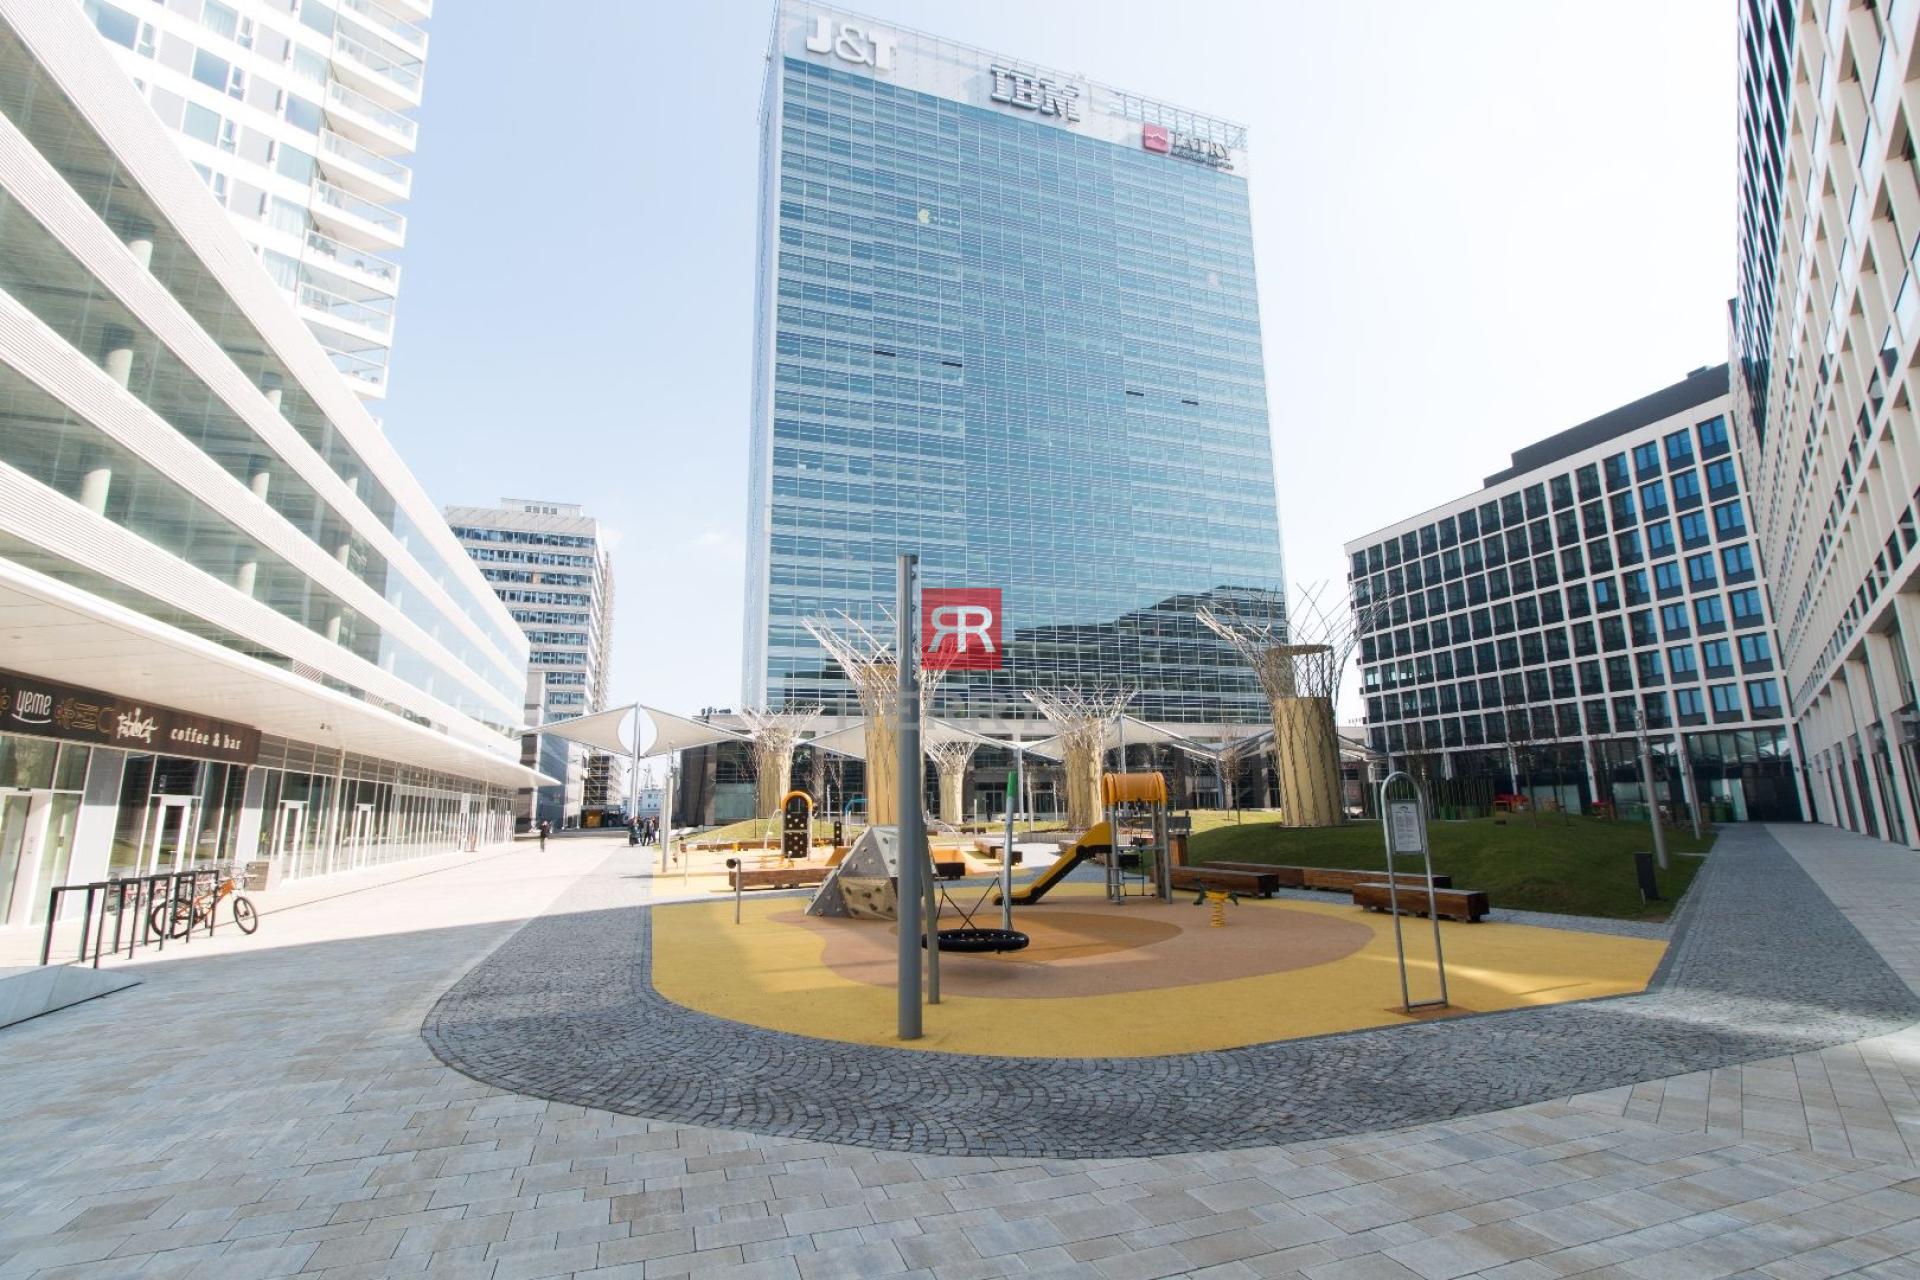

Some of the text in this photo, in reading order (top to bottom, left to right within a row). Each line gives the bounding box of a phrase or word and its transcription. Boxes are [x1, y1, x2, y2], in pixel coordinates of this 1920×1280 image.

[805, 15, 896, 71] J&T
[991, 64, 1080, 122] IBM
[1169, 131, 1231, 161] TATRY
[16, 689, 52, 719] yeme
[171, 727, 242, 750] coffee & bar
